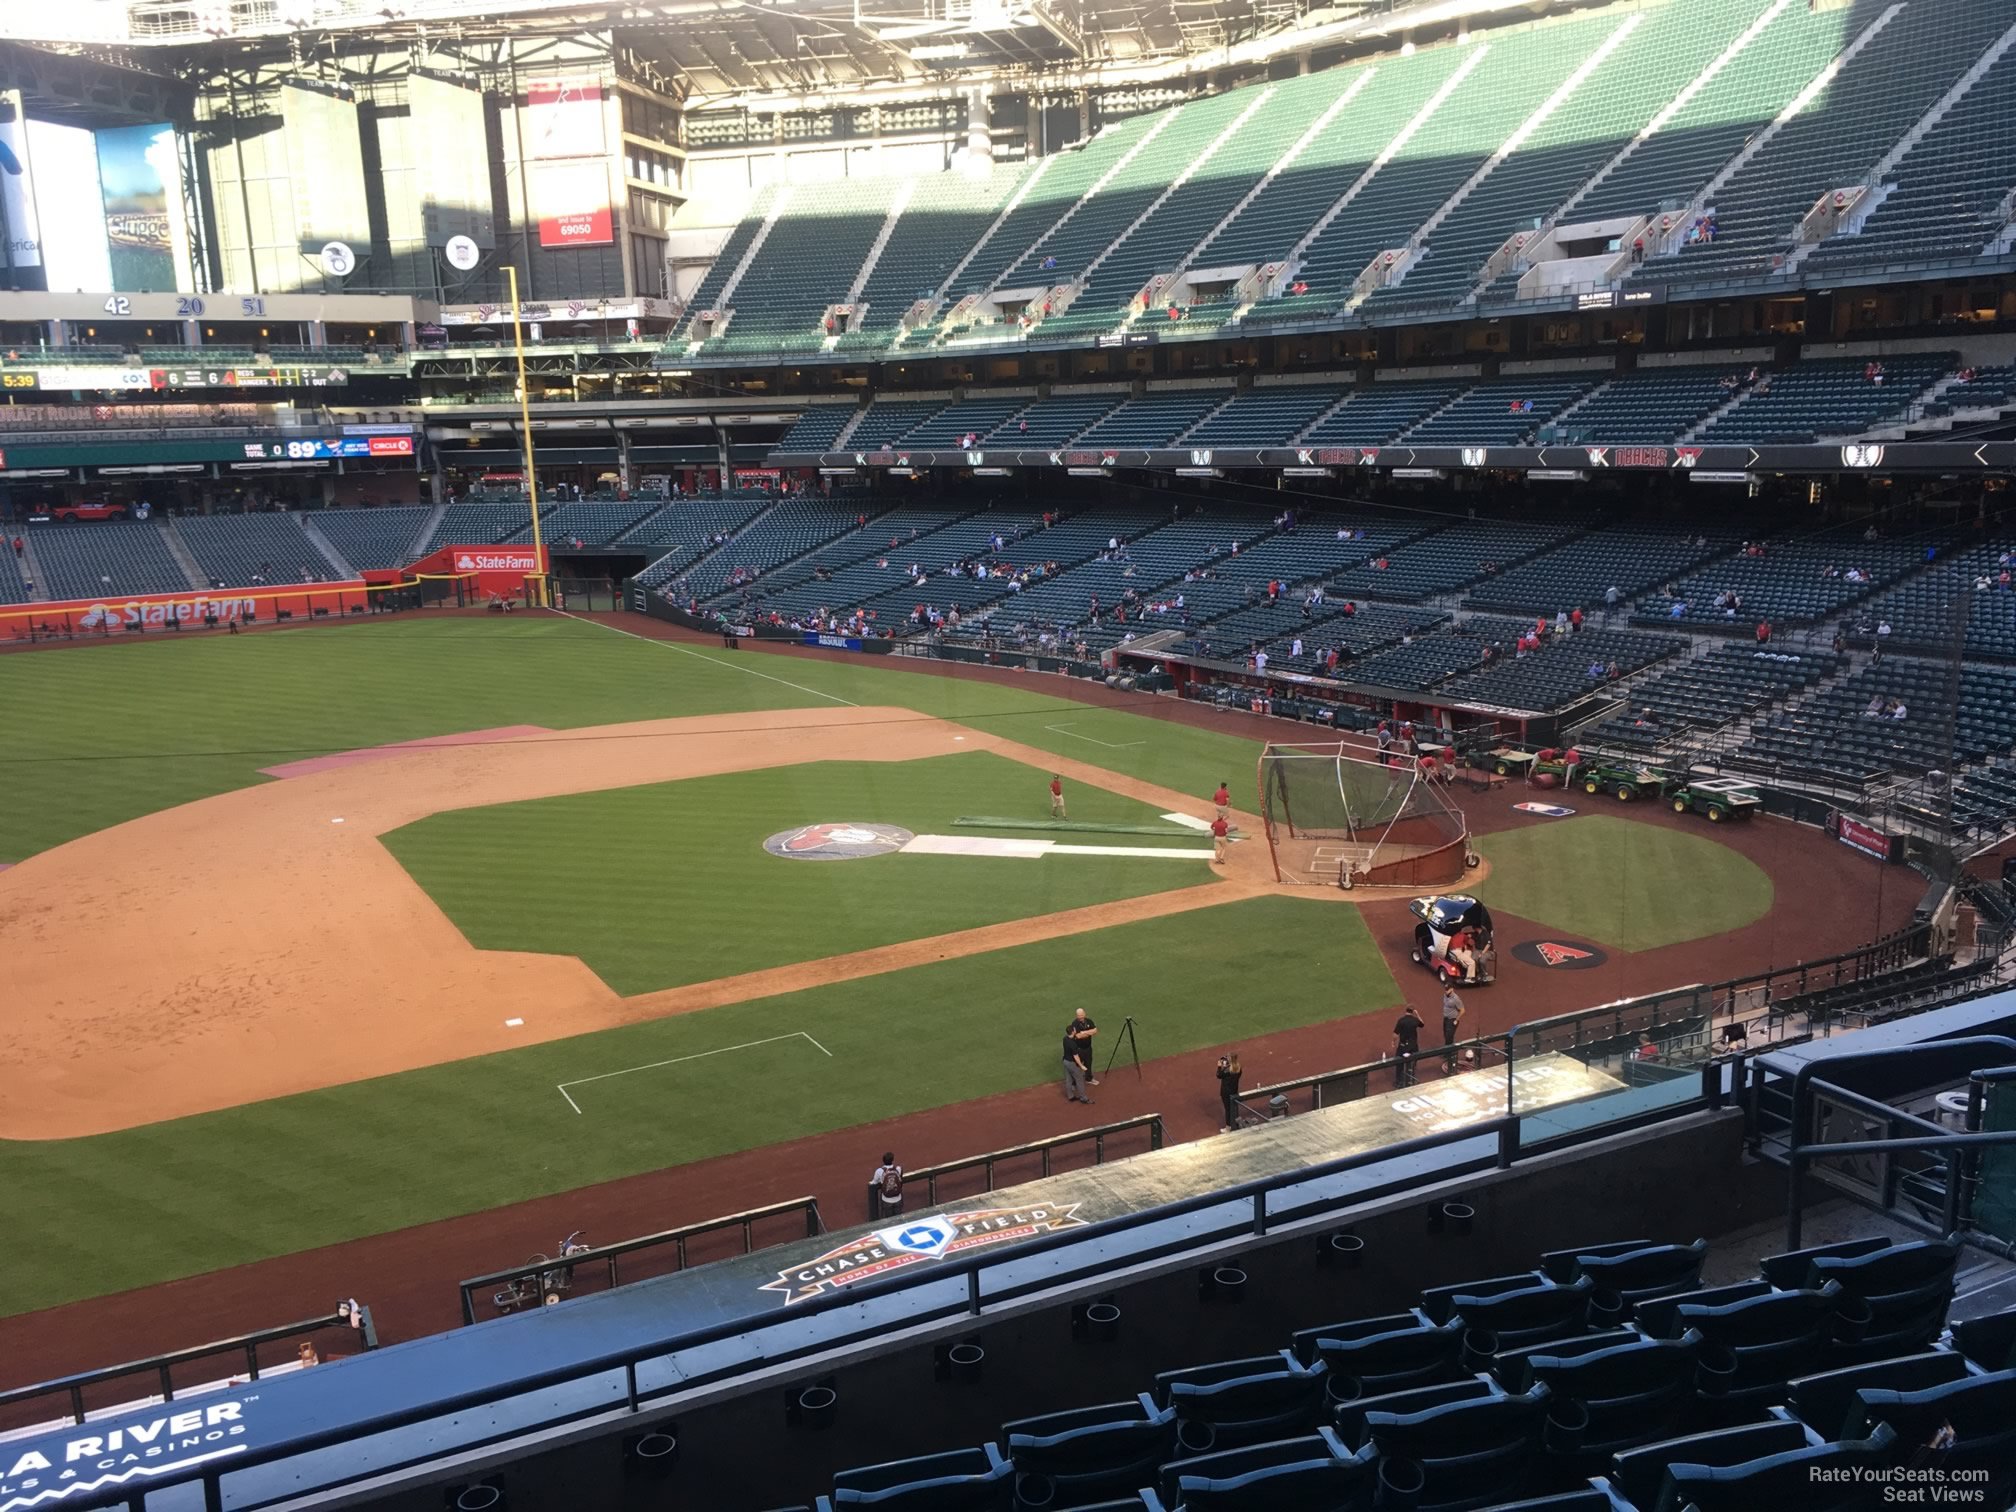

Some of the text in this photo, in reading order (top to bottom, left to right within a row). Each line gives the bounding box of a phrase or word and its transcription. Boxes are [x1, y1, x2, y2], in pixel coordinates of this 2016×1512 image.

[560, 224, 592, 236] 69050
[104, 296, 130, 314] 42
[176, 297, 205, 316] 20
[241, 298, 267, 316] 51
[3, 375, 34, 387] 5:39
[169, 372, 178, 384] 6
[209, 372, 218, 384] 6
[964, 1210, 1048, 1234] FIELD
[798, 1248, 886, 1281] CHASE
[838, 1270, 869, 1282] HOME
[896, 1256, 916, 1264] THE
[0, 1450, 52, 1479] A
[66, 1401, 244, 1462] RIVER
[59, 1468, 77, 1480] &
[97, 1424, 247, 1470] CASINOS
